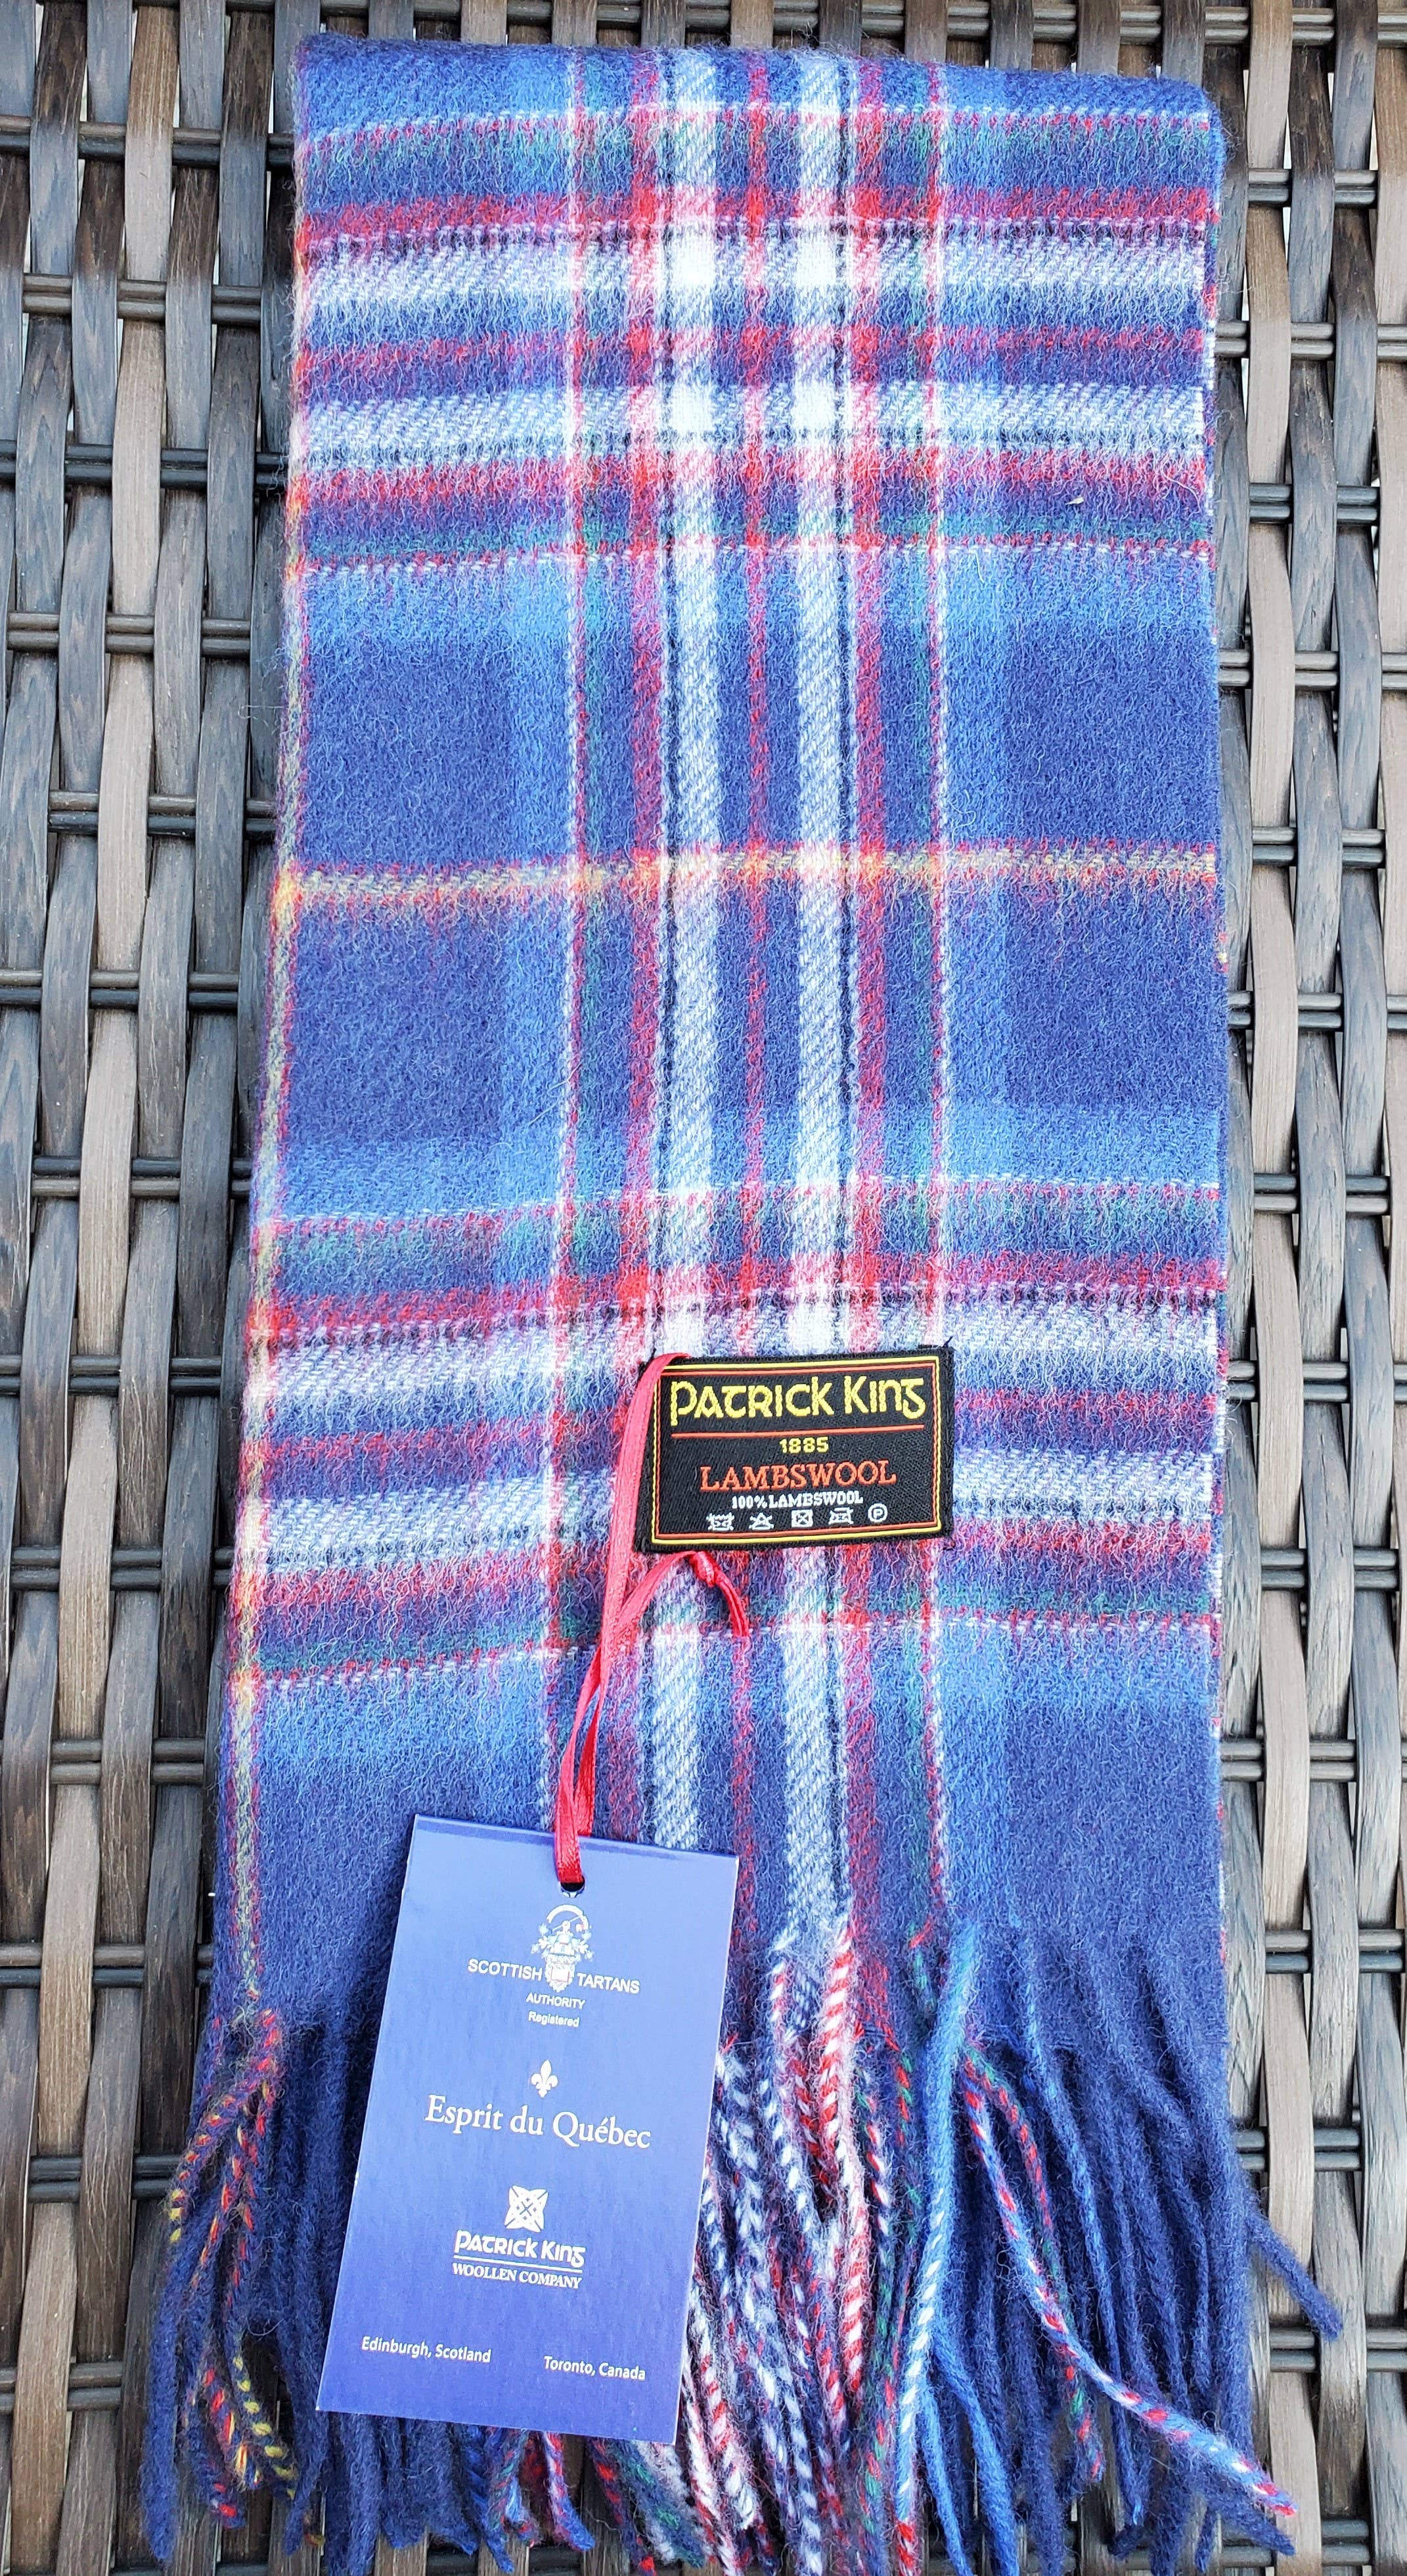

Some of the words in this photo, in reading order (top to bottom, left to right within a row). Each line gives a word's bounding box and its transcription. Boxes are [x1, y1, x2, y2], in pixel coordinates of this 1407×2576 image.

[779, 1436, 829, 1454] 1885
[700, 1460, 897, 1491] LAMBSWOOL
[468, 1958, 543, 1981] SCOTTISH
[577, 1973, 640, 1994] TARTANS
[525, 1992, 586, 2009] AUTHORITY
[528, 2011, 580, 2028] Registered
[425, 2094, 504, 2134] Esprit
[510, 2105, 544, 2135] du
[552, 2111, 652, 2149] Québec
[452, 2262, 518, 2282] WOOLLEN
[519, 2271, 583, 2289] COMPANY
[361, 2336, 432, 2359] Edinburgh,
[435, 2344, 492, 2363] Scotland
[543, 2355, 596, 2377] Toronto,
[599, 2362, 646, 2380] Canada
